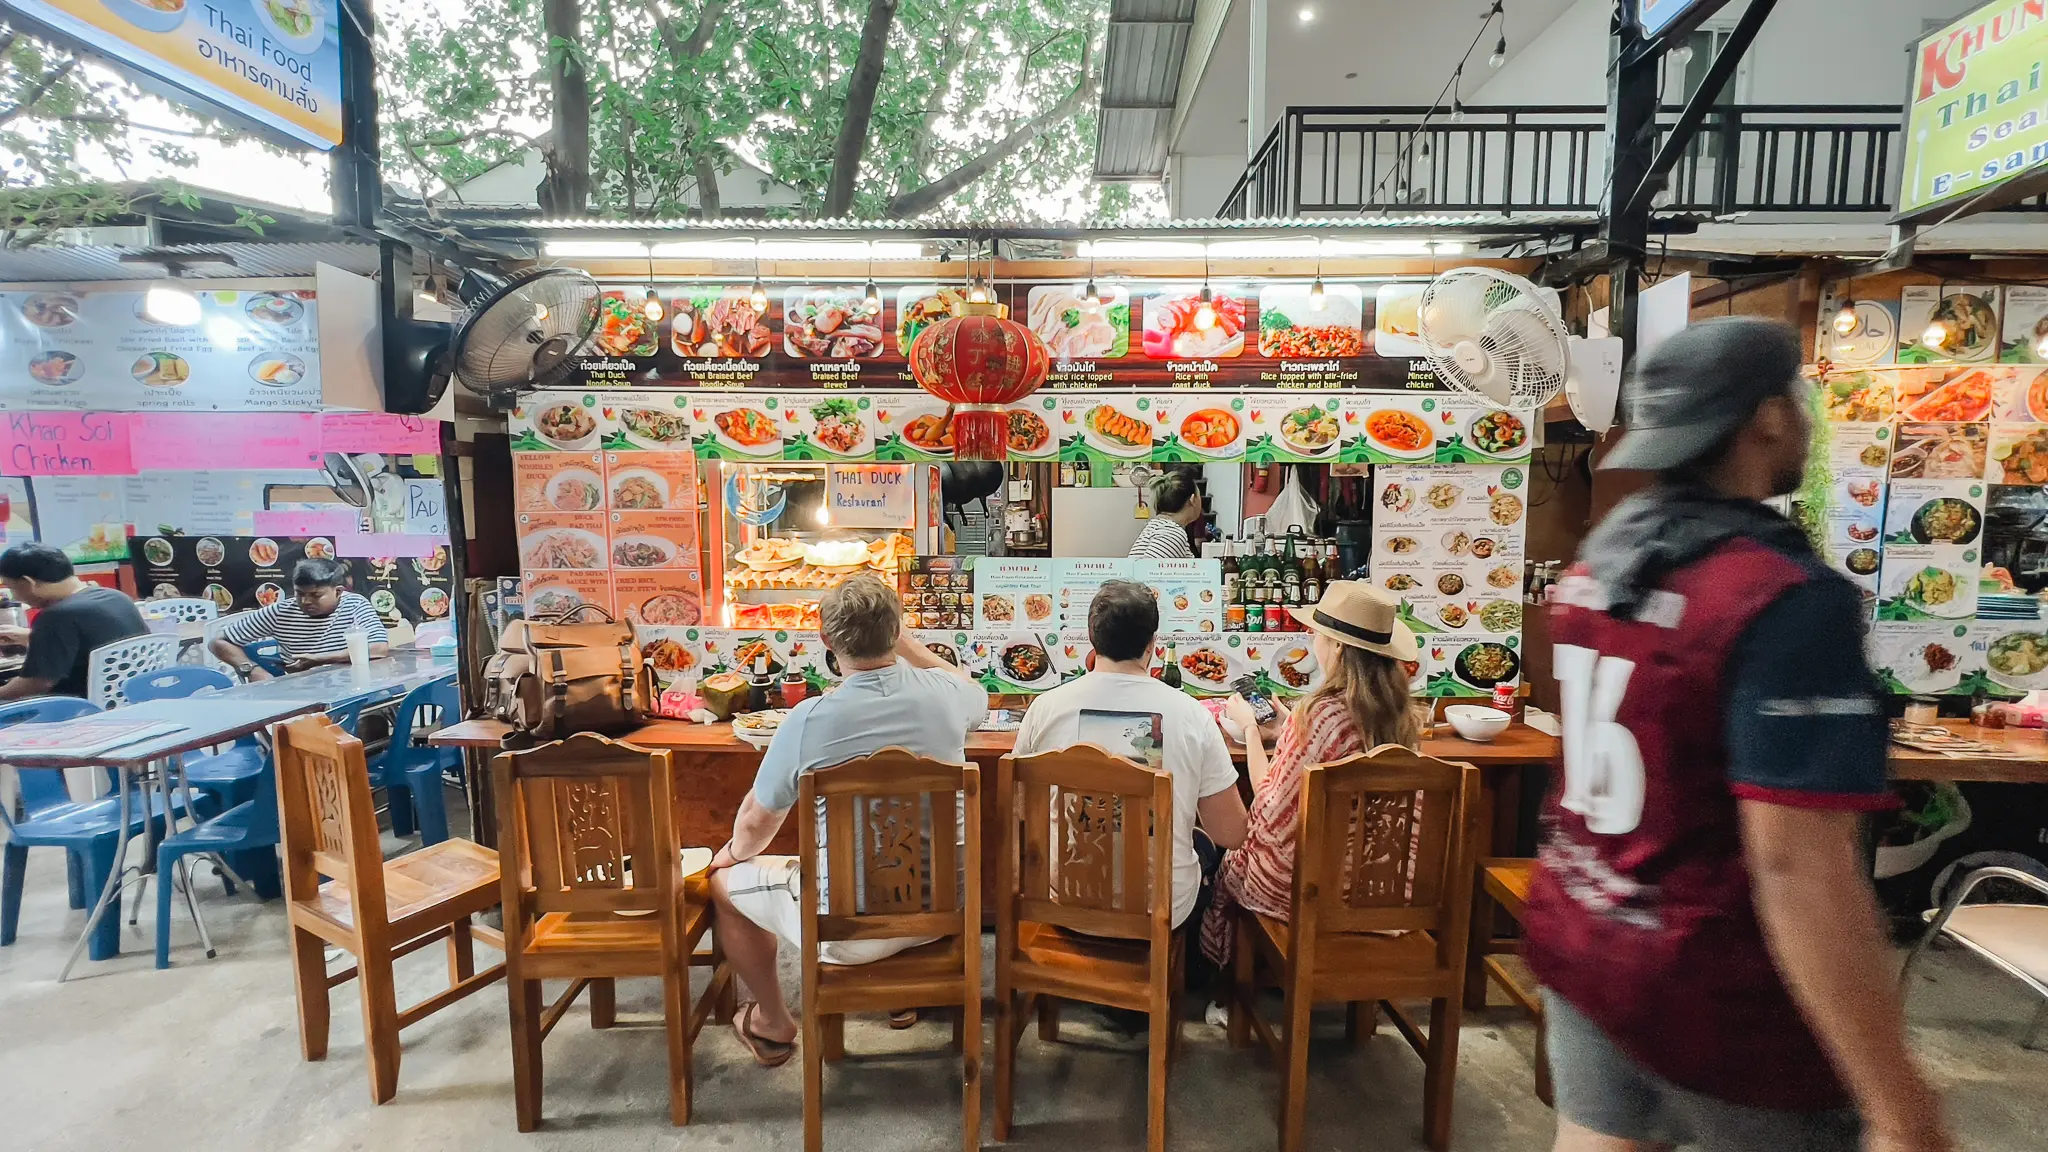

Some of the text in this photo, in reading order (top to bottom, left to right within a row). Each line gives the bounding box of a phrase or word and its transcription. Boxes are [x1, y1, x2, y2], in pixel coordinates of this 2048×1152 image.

[204, 4, 312, 83] Thai Food
[198, 37, 319, 114] อาหารตามสั่ง
[1936, 61, 2041, 129] Thai
[1966, 105, 2048, 150] Sea
[590, 371, 626, 379] Thai Duck
[690, 372, 753, 380] Thai Braised Beef
[1046, 373, 1069, 381] eamed
[1088, 373, 1113, 382] topped
[1175, 373, 1209, 381] Rice with
[1260, 372, 1358, 382] Rice topped with stir-fried
[1408, 372, 1433, 380] Minced
[823, 381, 848, 389] stewed
[244, 399, 278, 408] Mango
[281, 399, 311, 408] Sticky
[79, 411, 114, 441] Soi
[834, 471, 902, 484] THAI DUCK
[410, 485, 438, 519] PAD
[837, 493, 887, 507] Restaurant
